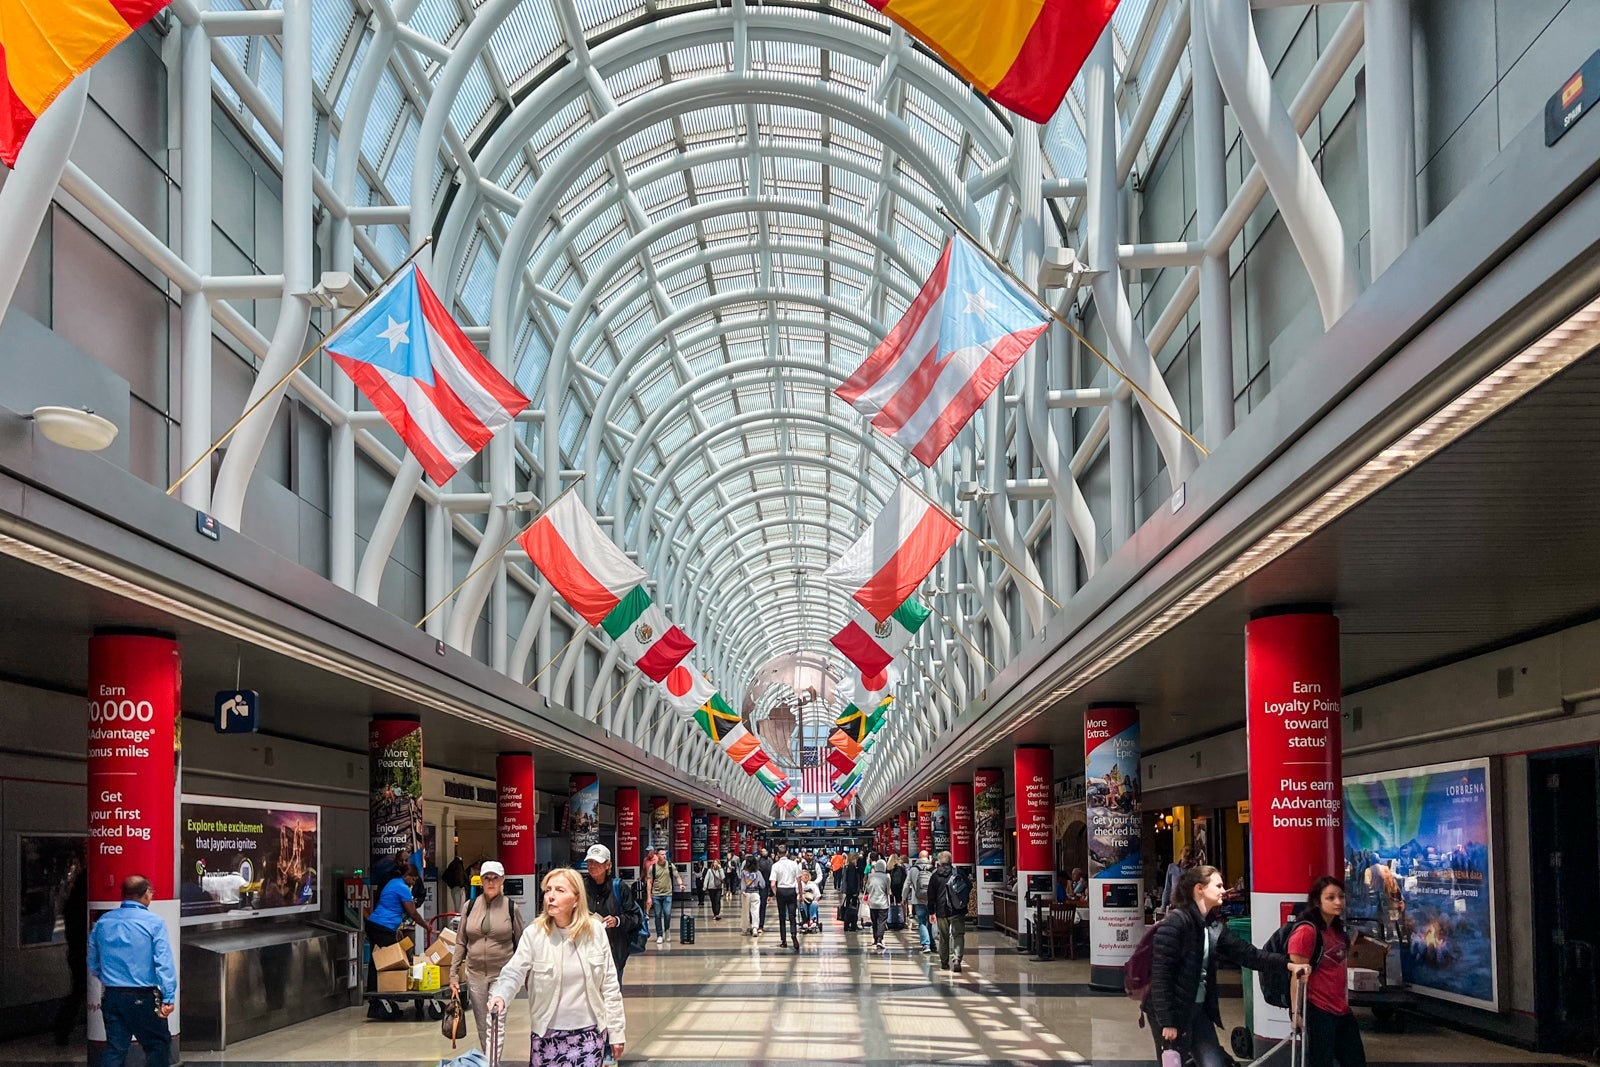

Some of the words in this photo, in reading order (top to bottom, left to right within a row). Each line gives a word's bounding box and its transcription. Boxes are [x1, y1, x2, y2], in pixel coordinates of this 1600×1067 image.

[1564, 102, 1582, 128] SPAIN
[100, 685, 126, 696] Earn
[1293, 681, 1321, 694] Earn
[1264, 699, 1310, 716] Loyalty
[1313, 699, 1340, 712] Points
[1086, 719, 1107, 728] More
[1284, 717, 1329, 730] toward
[88, 728, 155, 743] Advantage®
[1087, 730, 1110, 739] Extras.
[1112, 738, 1135, 747] More
[115, 745, 149, 757] miles
[384, 749, 409, 758] More
[1280, 778, 1307, 791] Plus
[1310, 780, 1334, 791] earn
[1446, 783, 1485, 797] LORBRENA
[101, 791, 122, 802] Get
[1027, 799, 1038, 807] bag
[1271, 796, 1340, 812] AAdvantage
[90, 810, 112, 823] your
[114, 807, 141, 820] first
[1273, 815, 1312, 827] bonus
[1315, 814, 1340, 827] miles
[187, 818, 215, 834] Explore
[216, 820, 228, 832] the
[228, 820, 264, 833] excitement
[1092, 816, 1106, 825] Get
[1107, 817, 1129, 827] your
[88, 825, 122, 837] hecked
[126, 825, 151, 840] bag
[376, 823, 399, 834] Enjoy
[1094, 827, 1128, 836] checked
[100, 842, 123, 854] free
[196, 836, 210, 849] that
[210, 837, 236, 852] Jaypirca
[236, 837, 257, 852] ignites
[1111, 838, 1129, 847] free
